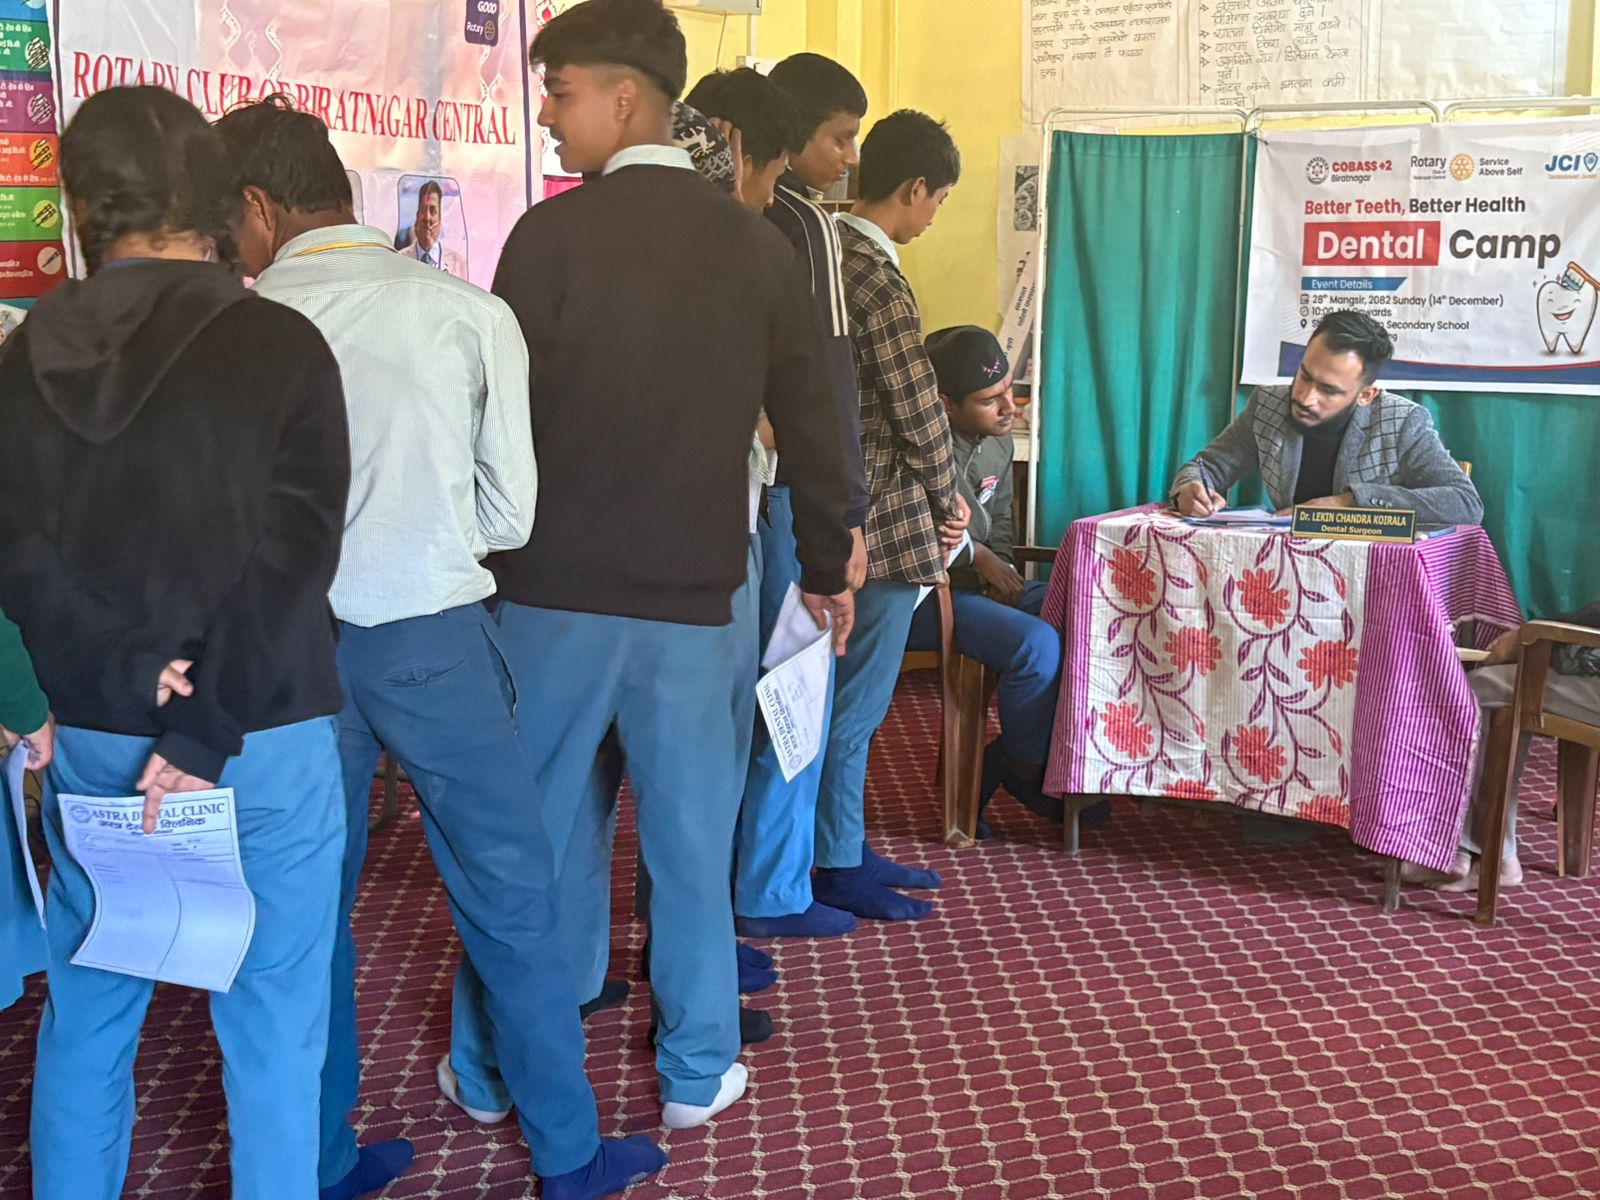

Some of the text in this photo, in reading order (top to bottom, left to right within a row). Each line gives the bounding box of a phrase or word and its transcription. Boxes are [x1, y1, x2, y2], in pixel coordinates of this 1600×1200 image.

[295, 83, 428, 141] BIRATNAGAR
[433, 100, 517, 145] CENTRAL
[1332, 161, 1377, 172] COBASS
[1410, 155, 1447, 169] Rotary
[1479, 157, 1509, 166] Service
[1545, 154, 1581, 172] JCI
[1479, 167, 1523, 176] Above Self
[1331, 174, 1371, 184] Biratnagar
[1304, 196, 1526, 216] Better Teeth, Better Health
[1317, 228, 1561, 269] Dental Camp
[1311, 279, 1373, 289] Event Details
[1330, 295, 1367, 307] Mangsir,
[1368, 295, 1391, 305] 2082
[1393, 296, 1427, 307] Sunday
[1449, 294, 1504, 307] December)
[1386, 320, 1435, 332] Secondary
[1437, 321, 1470, 330] School
[1299, 511, 1407, 527] Dr. LEKIN CHANDRA KOIRALA
[1321, 525, 1382, 535] Dental Surgeon
[132, 807, 180, 821] DTAL
[182, 802, 225, 817] CLINIC
